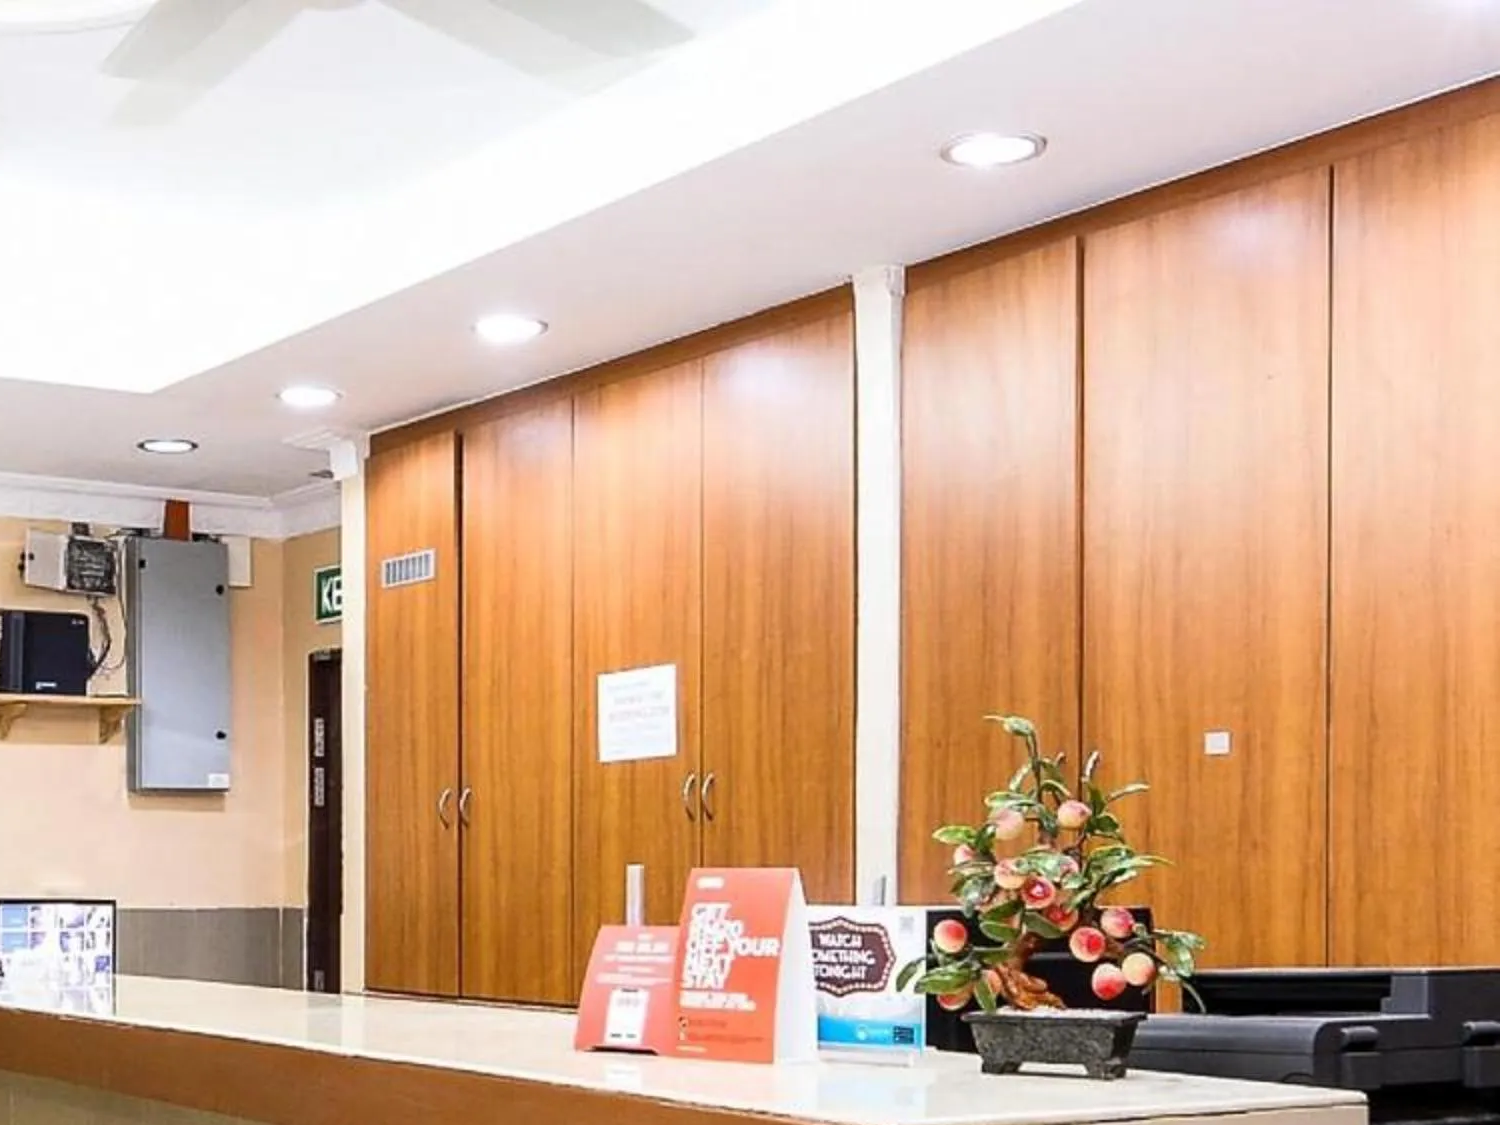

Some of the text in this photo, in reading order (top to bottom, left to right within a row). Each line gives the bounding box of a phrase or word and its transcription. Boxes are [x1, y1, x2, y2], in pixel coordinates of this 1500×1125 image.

[726, 936, 780, 956] YOUR
[812, 949, 876, 965] OMETHING
[682, 972, 726, 989] STAY
